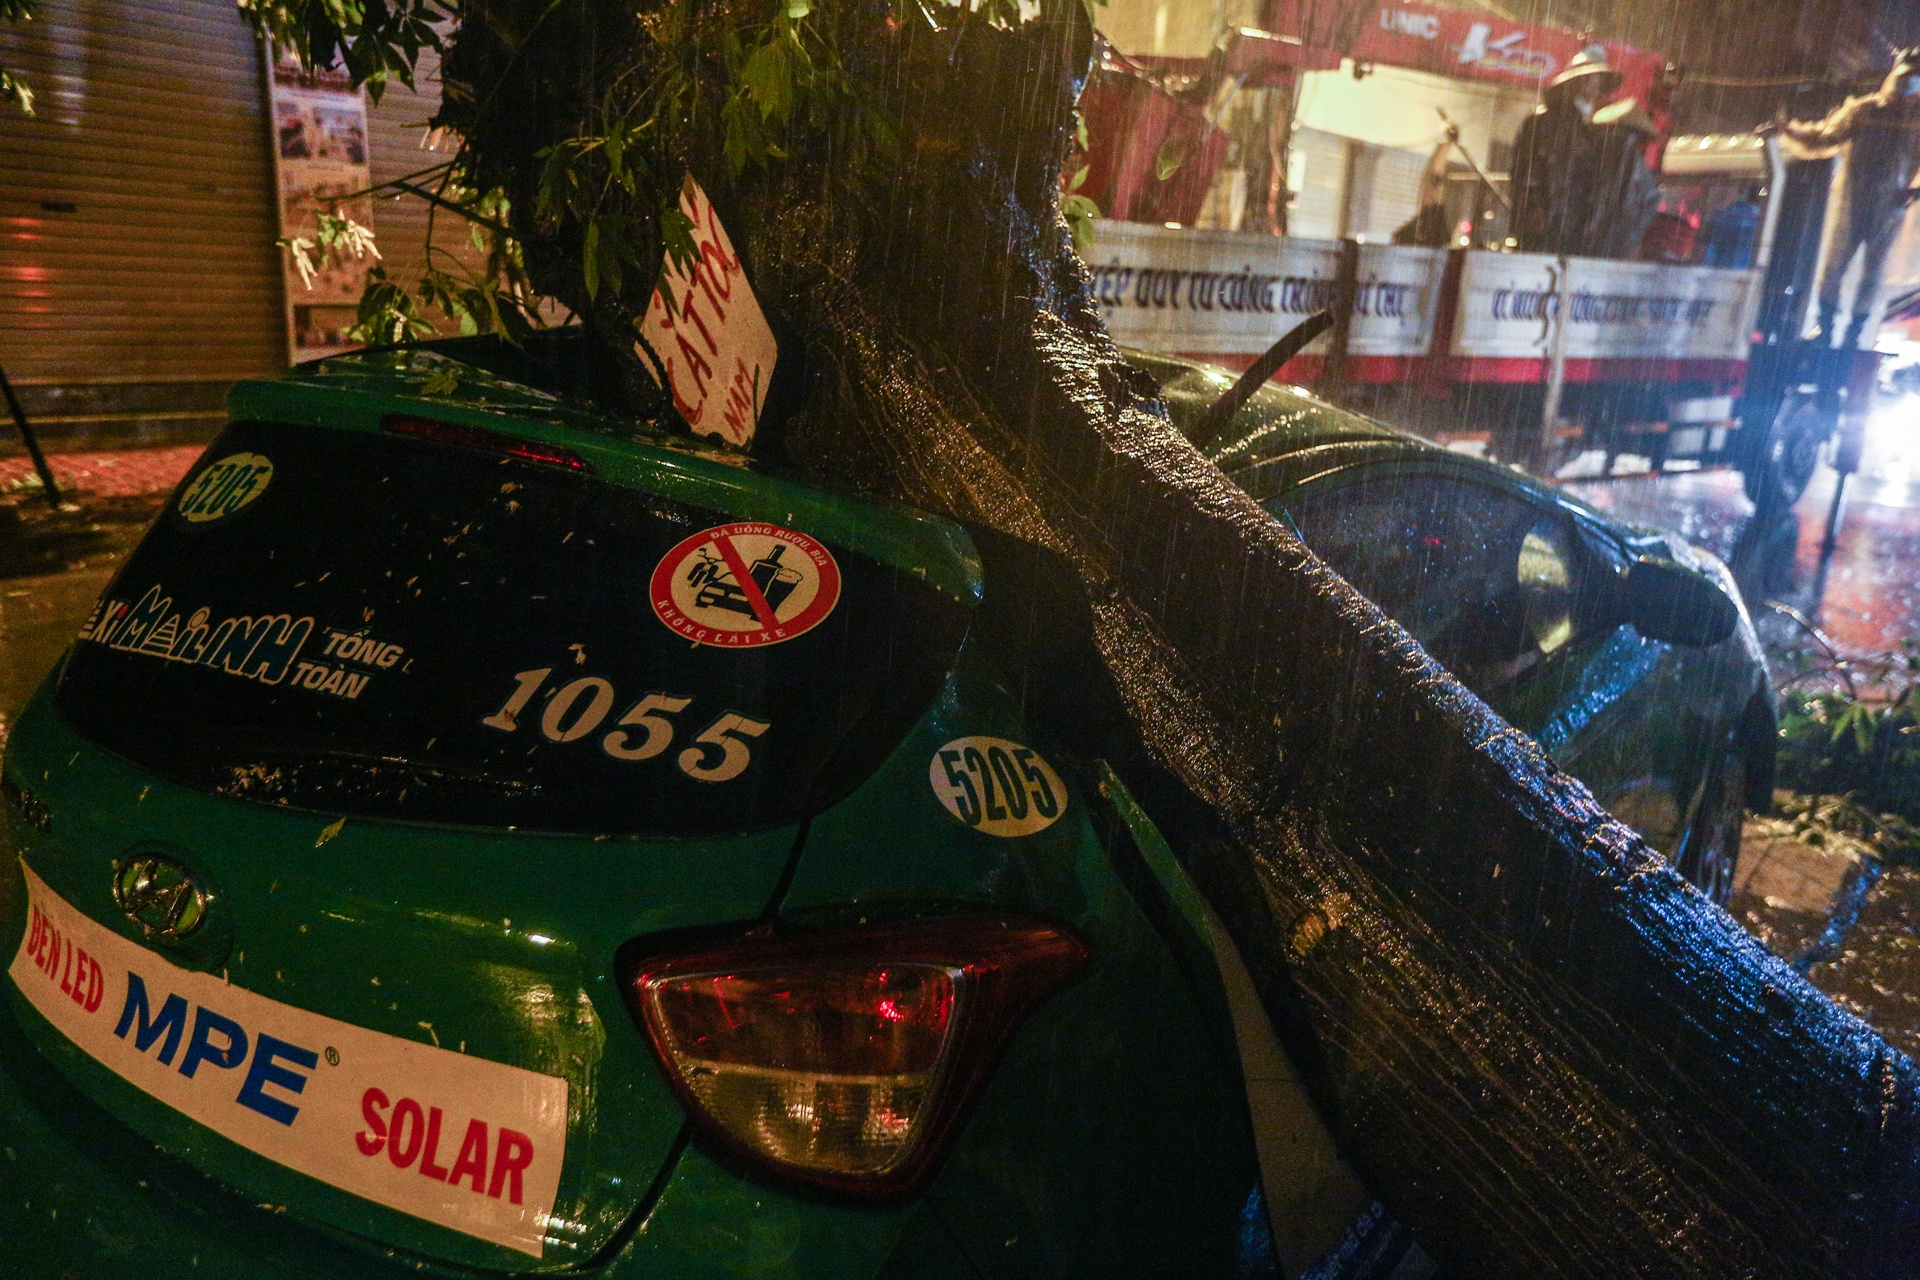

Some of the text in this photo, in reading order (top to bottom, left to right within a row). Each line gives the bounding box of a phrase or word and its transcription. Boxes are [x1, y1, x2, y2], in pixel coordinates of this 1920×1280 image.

[181, 463, 270, 514] 5205
[656, 599, 707, 639] KHÔNG
[761, 628, 787, 642] XE
[290, 662, 371, 699] TOÀN
[482, 667, 771, 783] 1055
[938, 746, 1058, 824] 5205
[60, 938, 104, 1014] LED
[355, 1087, 534, 1206] SOLAR
